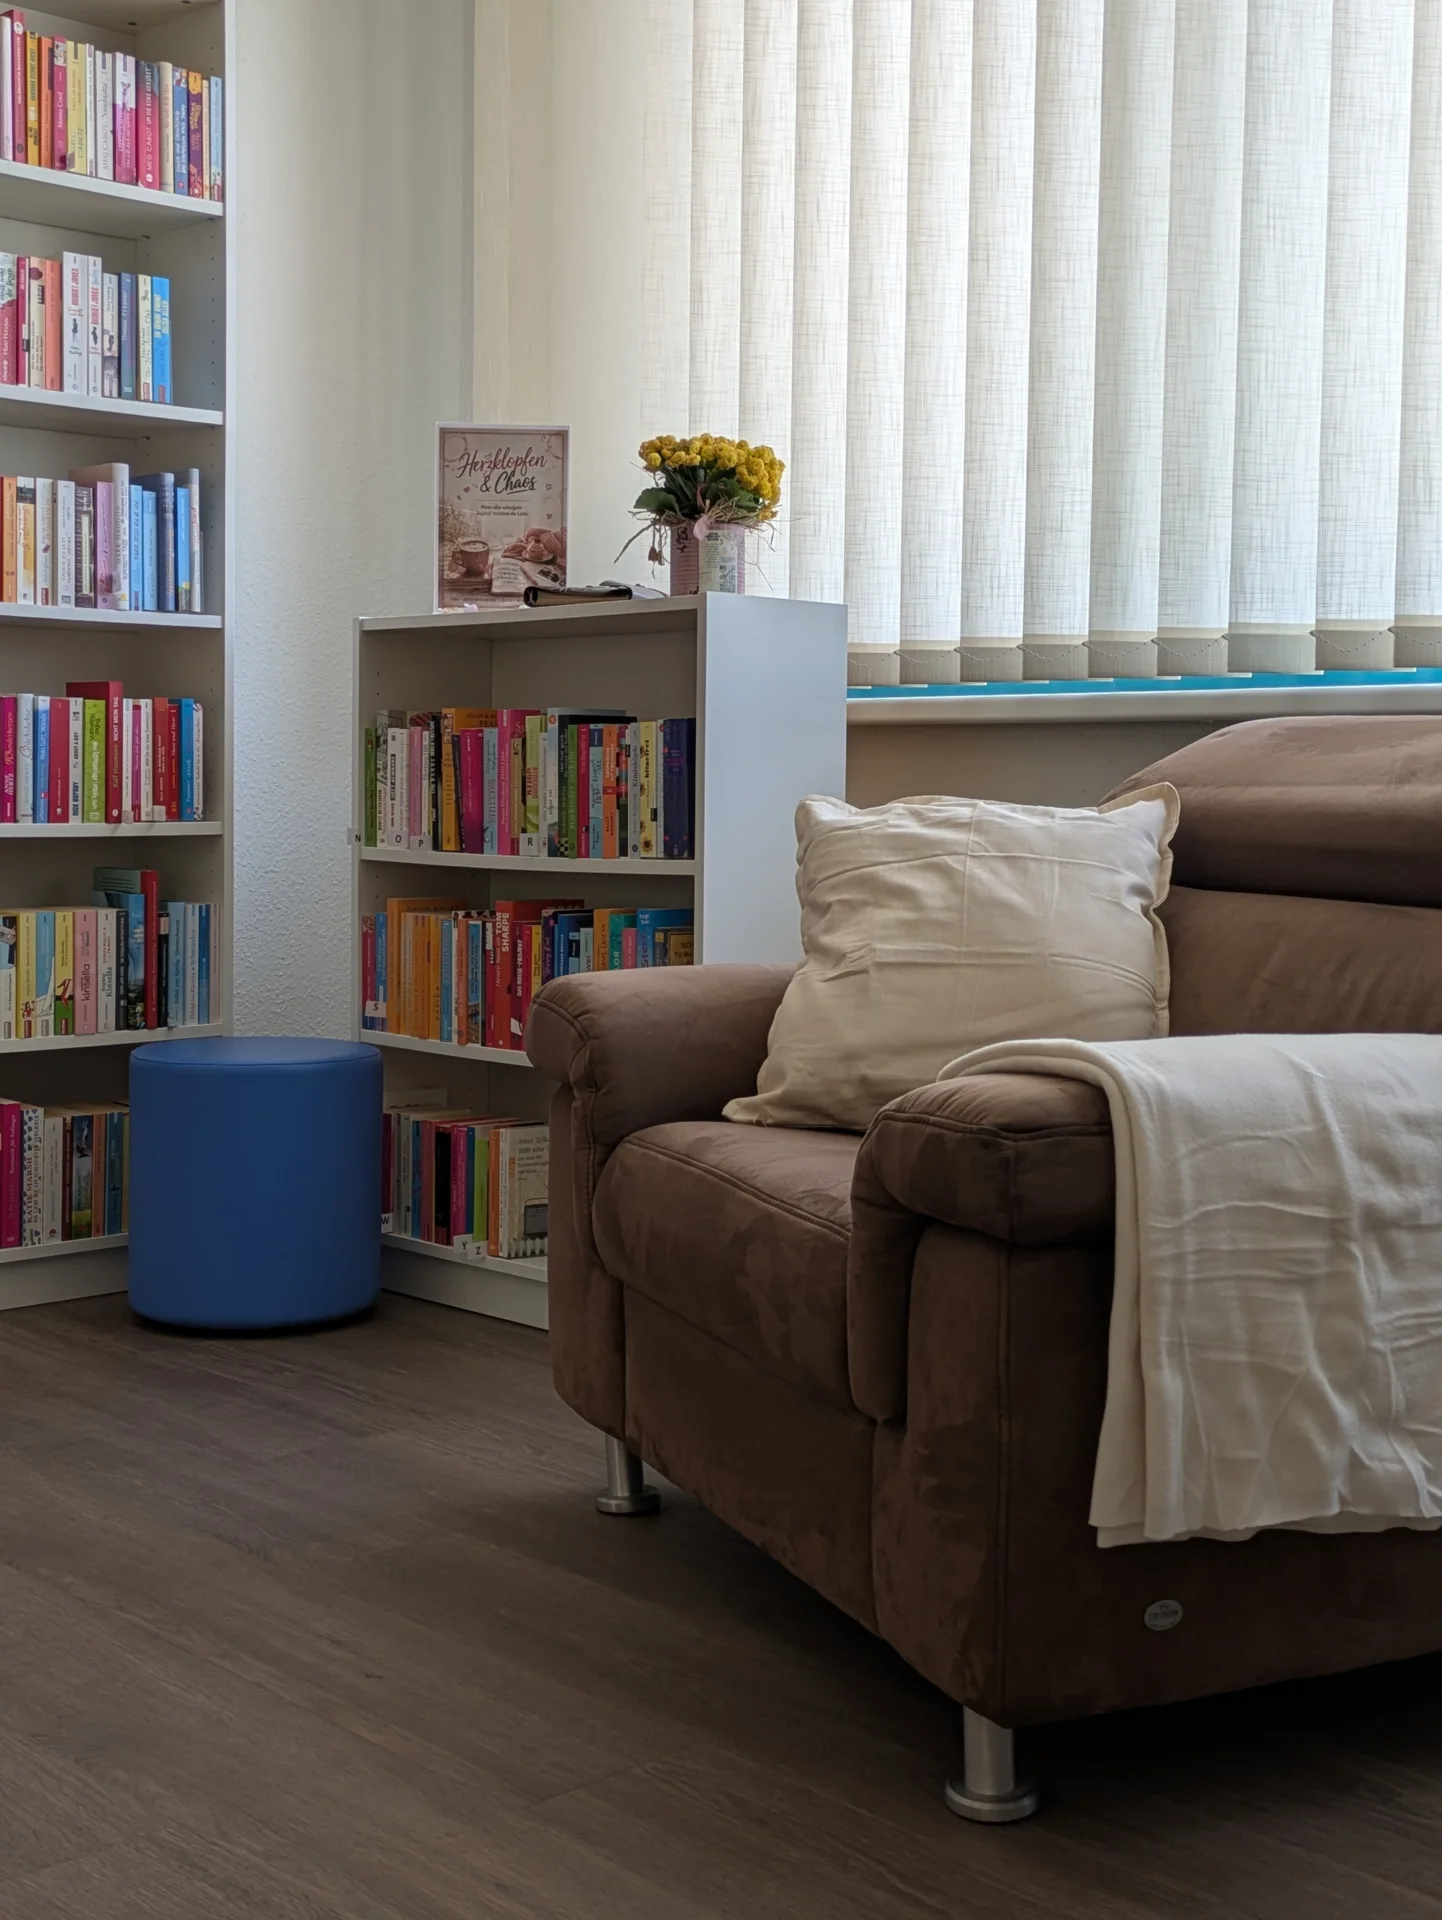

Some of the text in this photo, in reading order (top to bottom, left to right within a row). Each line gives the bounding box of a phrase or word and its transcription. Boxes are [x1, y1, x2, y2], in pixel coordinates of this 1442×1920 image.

[56, 91, 64, 130] Mama Cool
[71, 268, 79, 306] BRIDGET JONES
[91, 287, 99, 325] BRIDGET JONES
[456, 447, 547, 478] Herzklopfen
[480, 471, 537, 495] & Chaos
[39, 712, 47, 731] Wanda
[4, 712, 13, 766] Wunderkerzen
[39, 746, 47, 759] Mein
[395, 835, 401, 843] O
[528, 838, 534, 846] R
[81, 964, 91, 1001] kinsella
[105, 967, 113, 997] Kinsella
[373, 1002, 379, 1011] S
[462, 1242, 467, 1250] Y
[476, 1246, 481, 1255] Z
